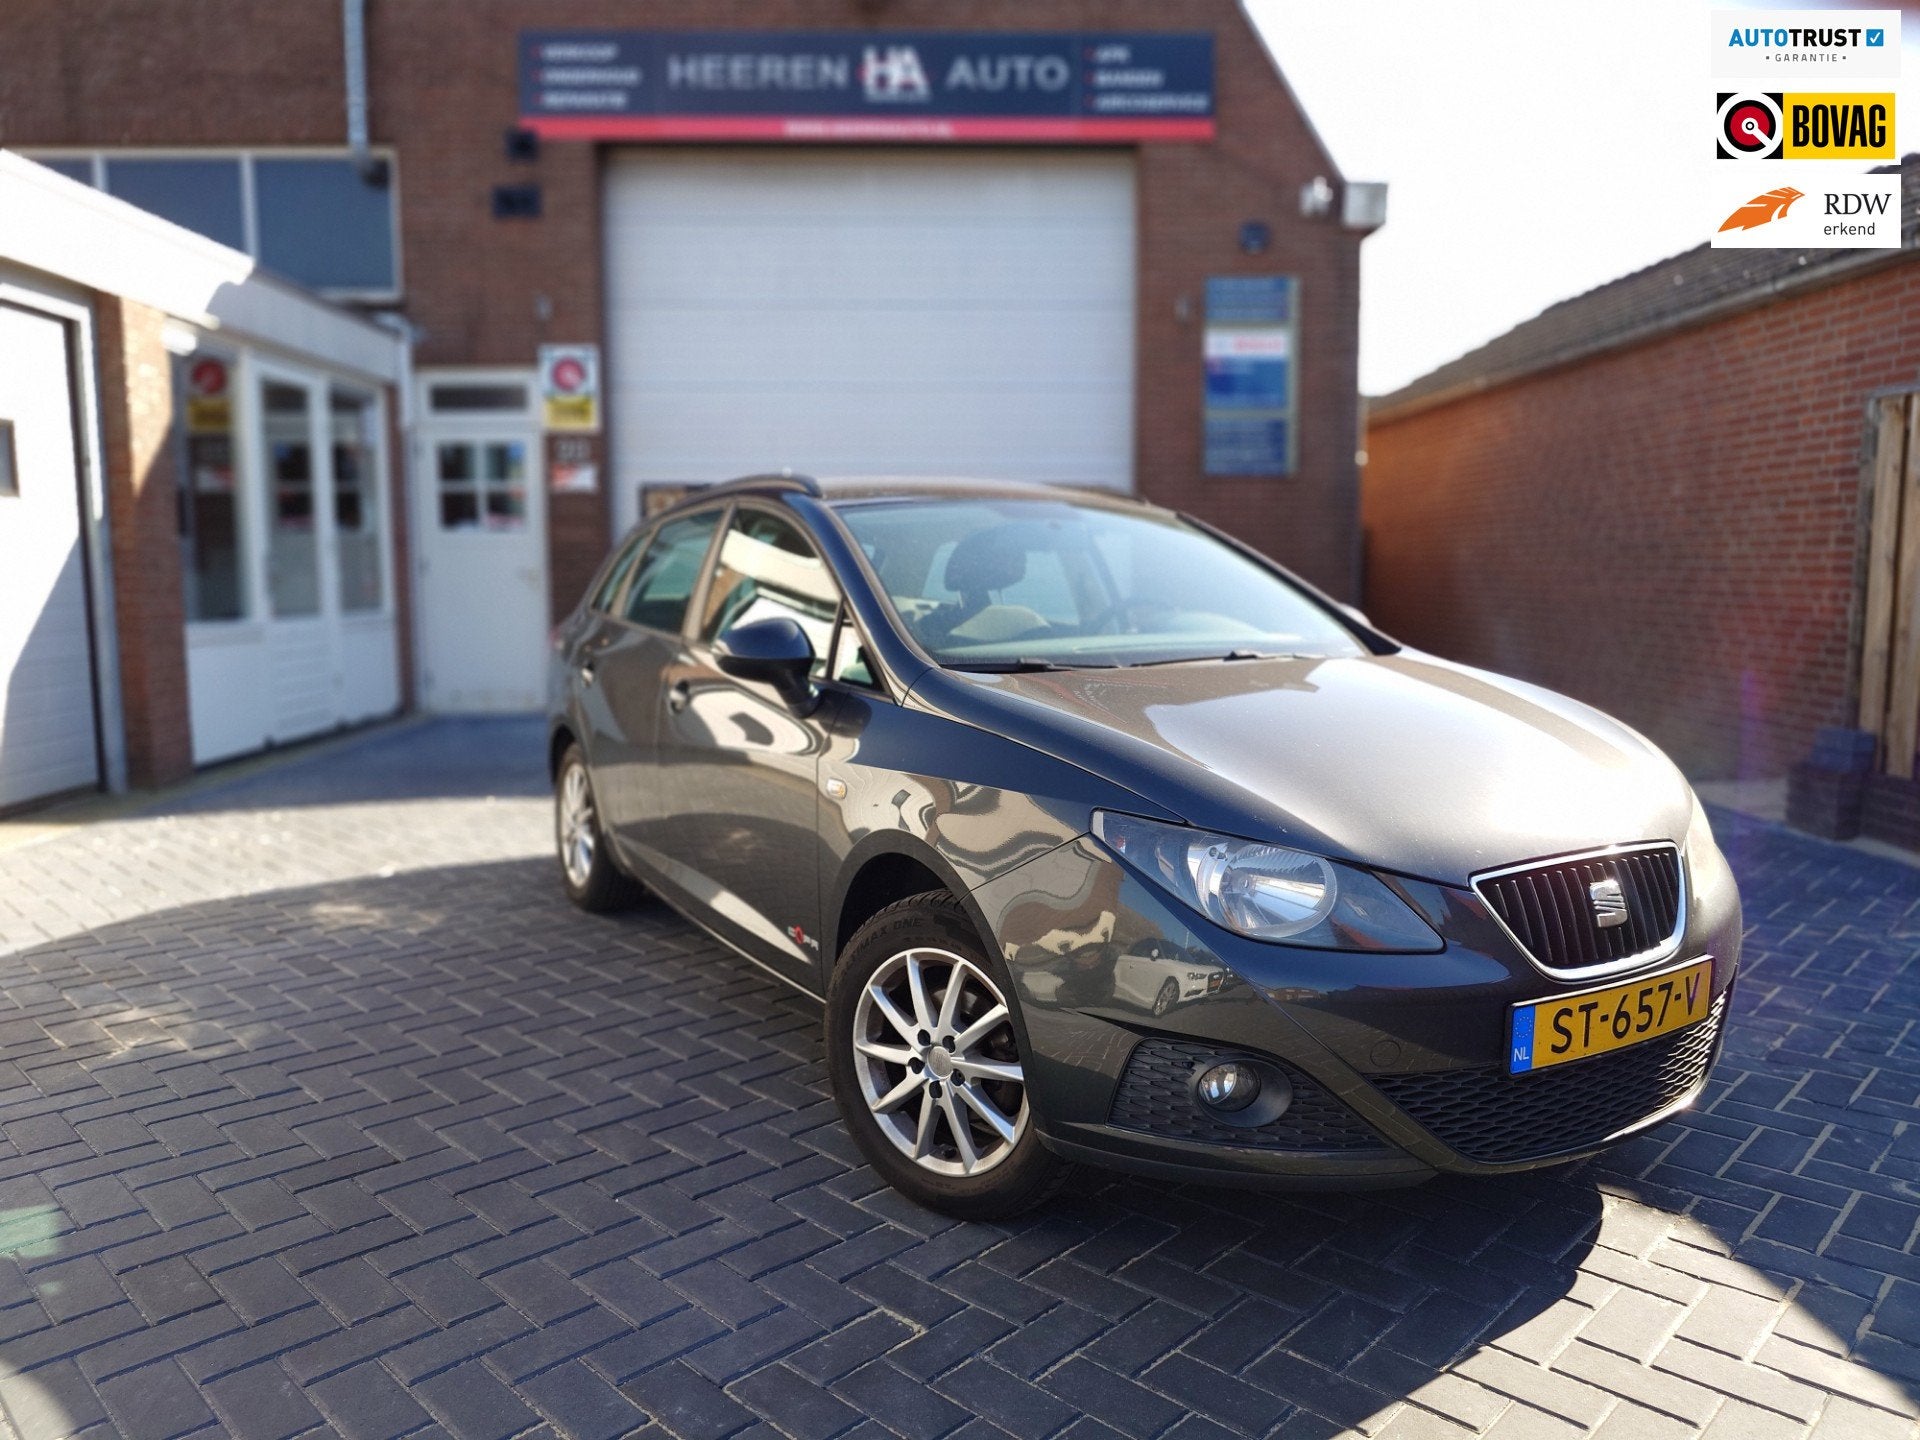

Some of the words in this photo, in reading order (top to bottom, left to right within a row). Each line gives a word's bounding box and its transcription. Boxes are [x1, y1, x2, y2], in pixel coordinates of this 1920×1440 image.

[666, 54, 848, 91] HEEREN
[946, 55, 1071, 92] AUTO
[1513, 1046, 1530, 1062] NL
[1550, 972, 1701, 1054] ST-657-V
